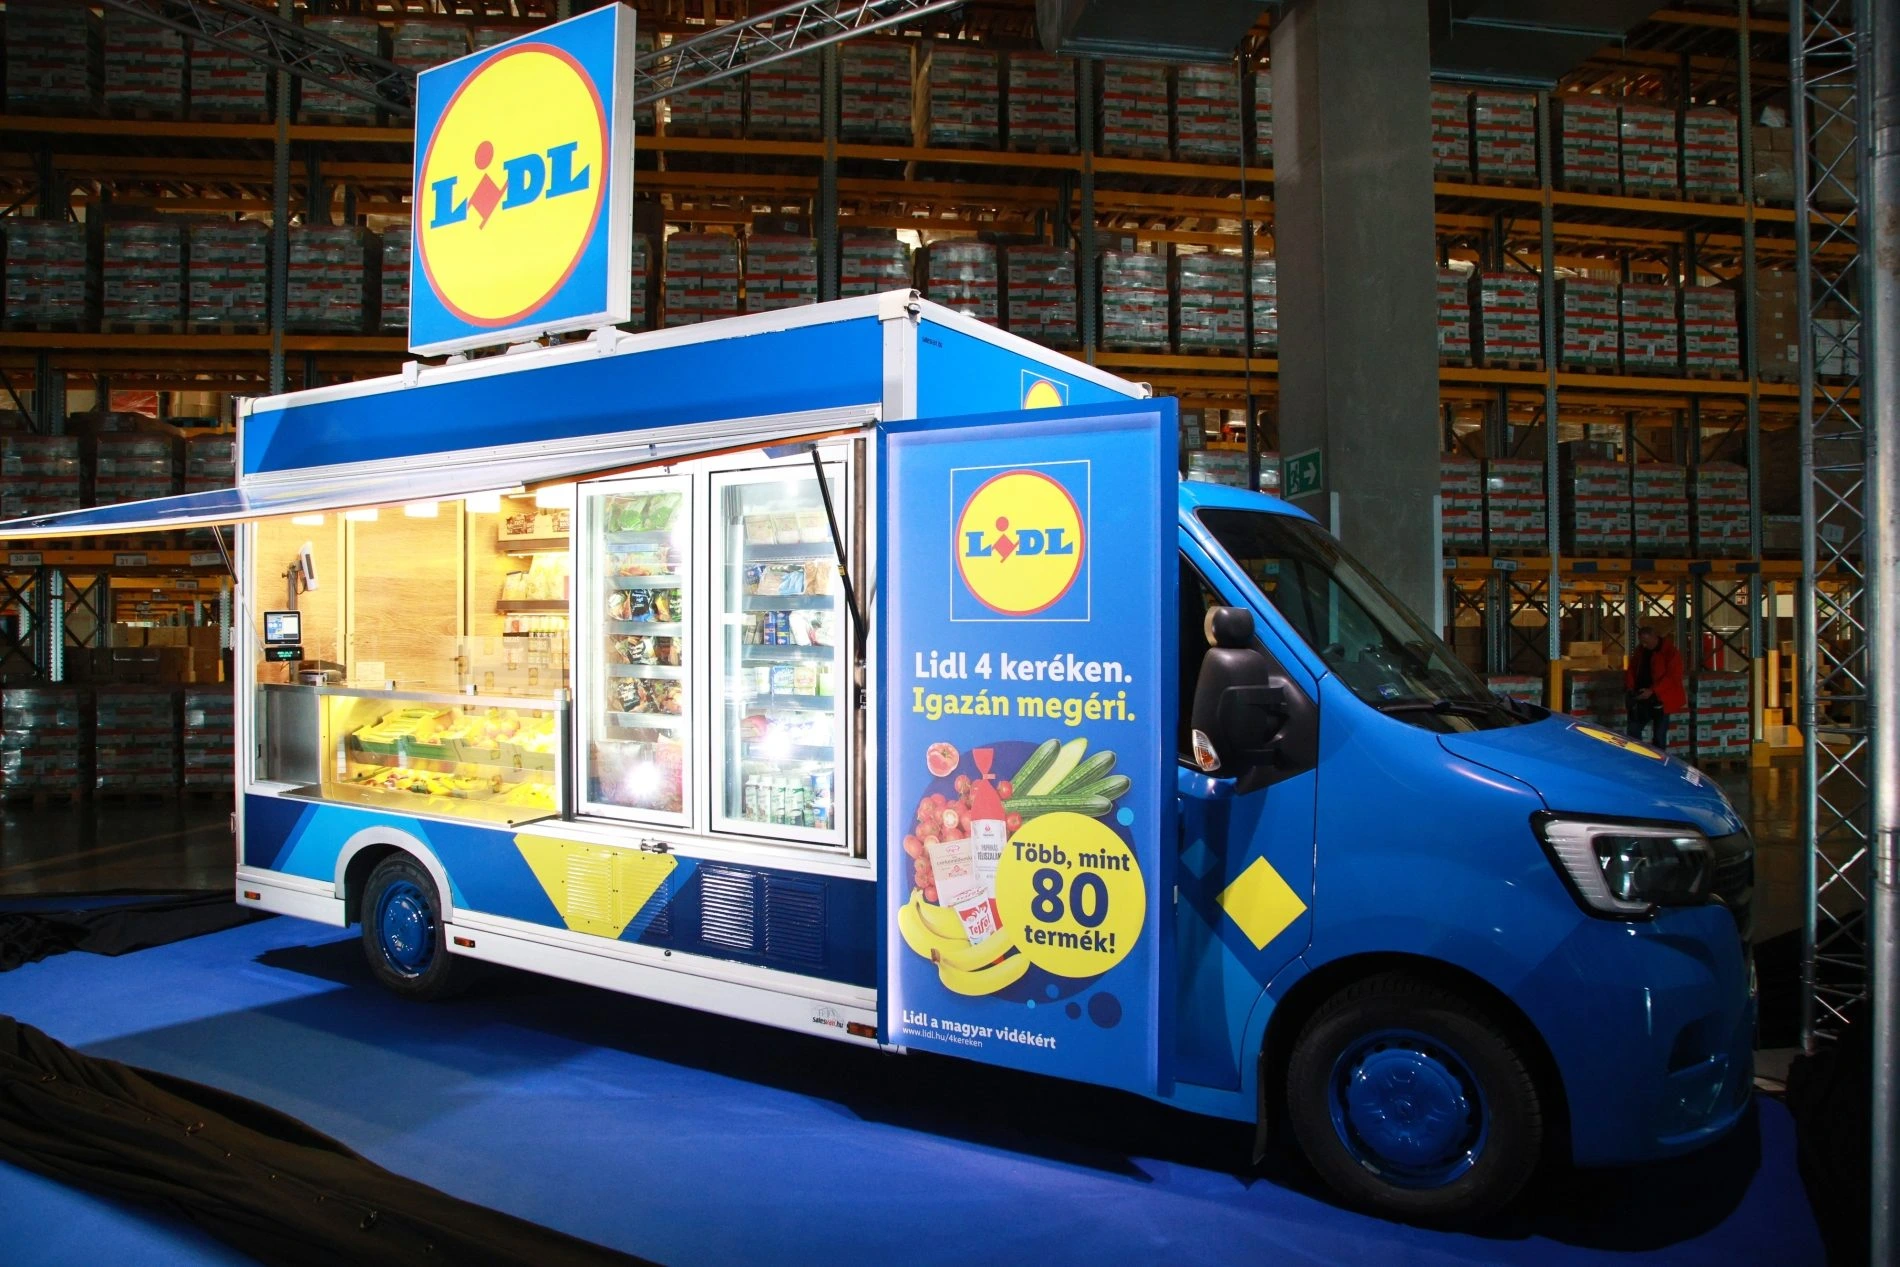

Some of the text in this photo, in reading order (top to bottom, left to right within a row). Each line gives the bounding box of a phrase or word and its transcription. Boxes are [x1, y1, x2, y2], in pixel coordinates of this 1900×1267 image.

[915, 650, 1132, 684] Lidl 4 keréken.
[912, 686, 1136, 727] Igazán megéri.
[1013, 841, 1131, 872] Több, mint
[1031, 867, 1109, 928] 80
[1024, 924, 1116, 955] termék!
[902, 1026, 983, 1048] www.lidl.hu/4kereken
[903, 1010, 1057, 1050] Lidl a magyar vidékért
